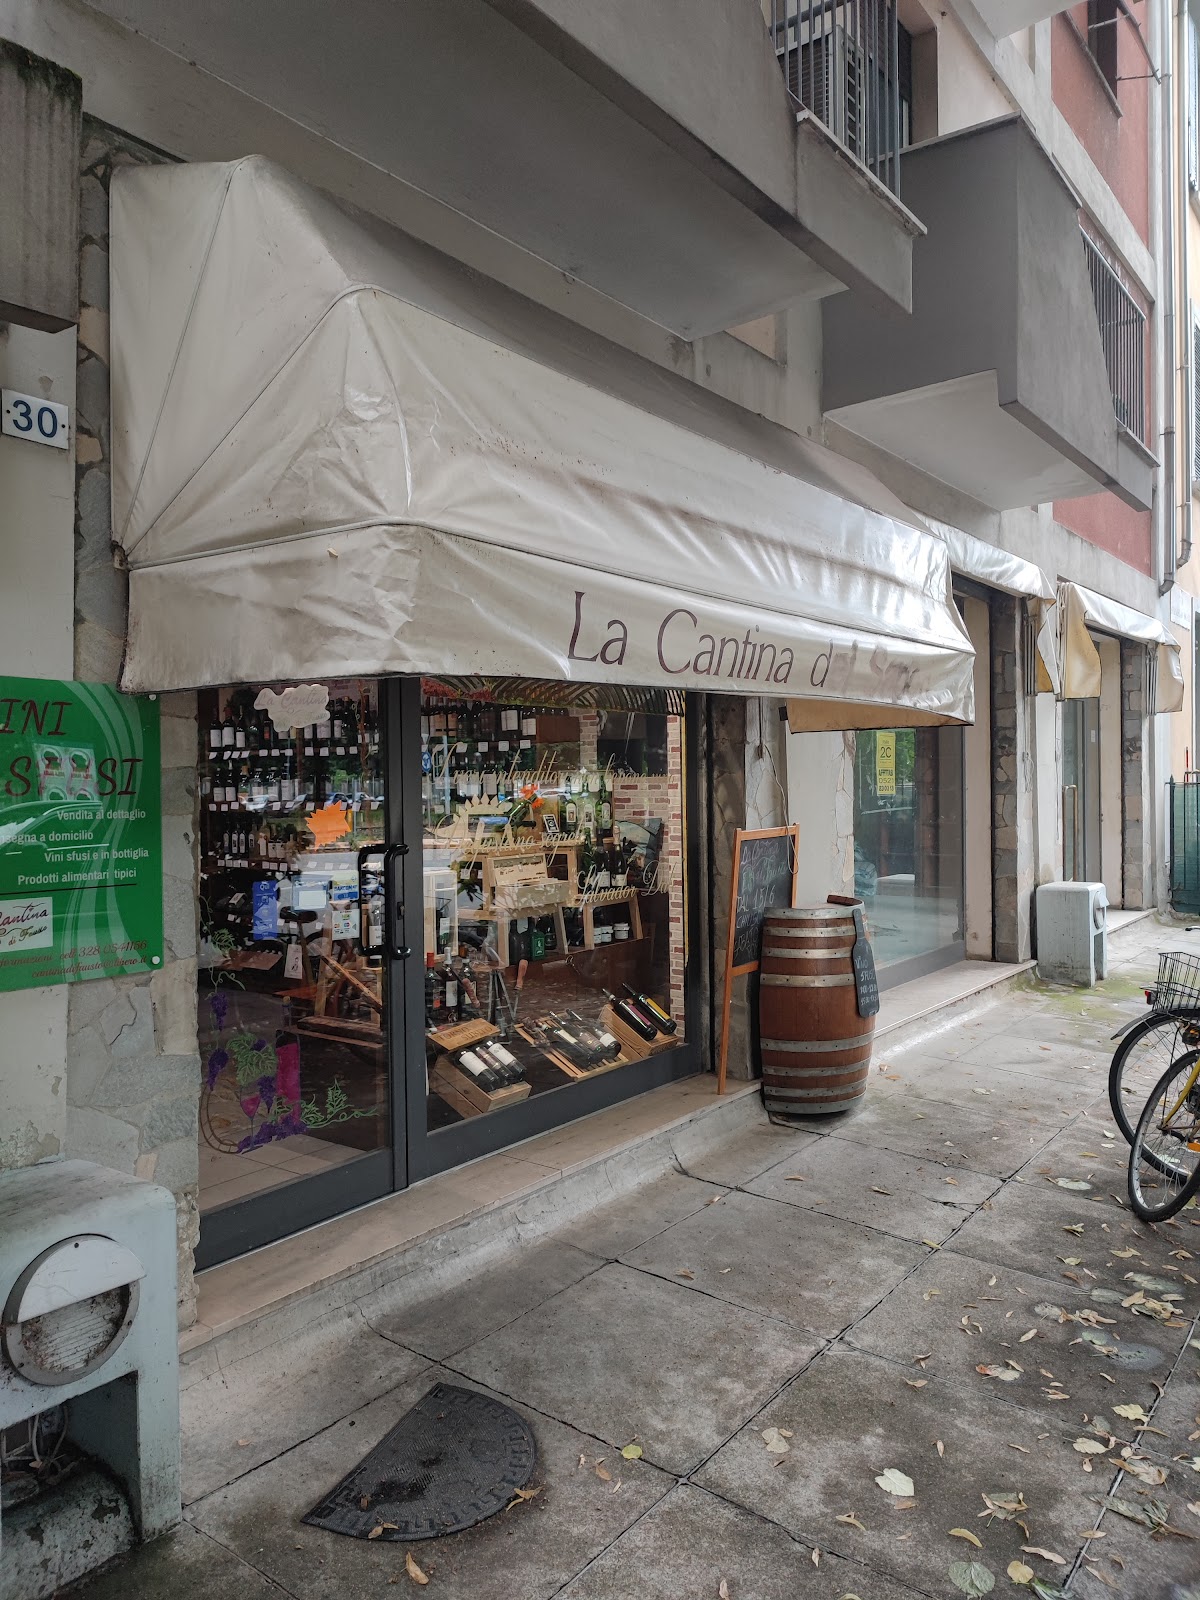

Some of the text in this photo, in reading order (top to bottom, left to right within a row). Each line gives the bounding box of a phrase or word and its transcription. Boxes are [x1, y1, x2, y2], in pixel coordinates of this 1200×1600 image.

[12, 399, 58, 438] 30
[567, 590, 629, 667] La
[656, 608, 795, 684] Cantina
[879, 746, 892, 758] 2C
[5, 756, 144, 797] SSI
[57, 809, 147, 821] Vendita al dettaglio
[39, 833, 46, 842] a
[48, 830, 94, 842] domicilio
[44, 848, 150, 863] Vini sfusi e in bottiglia
[17, 867, 138, 886] Prodotti alimentari tipici
